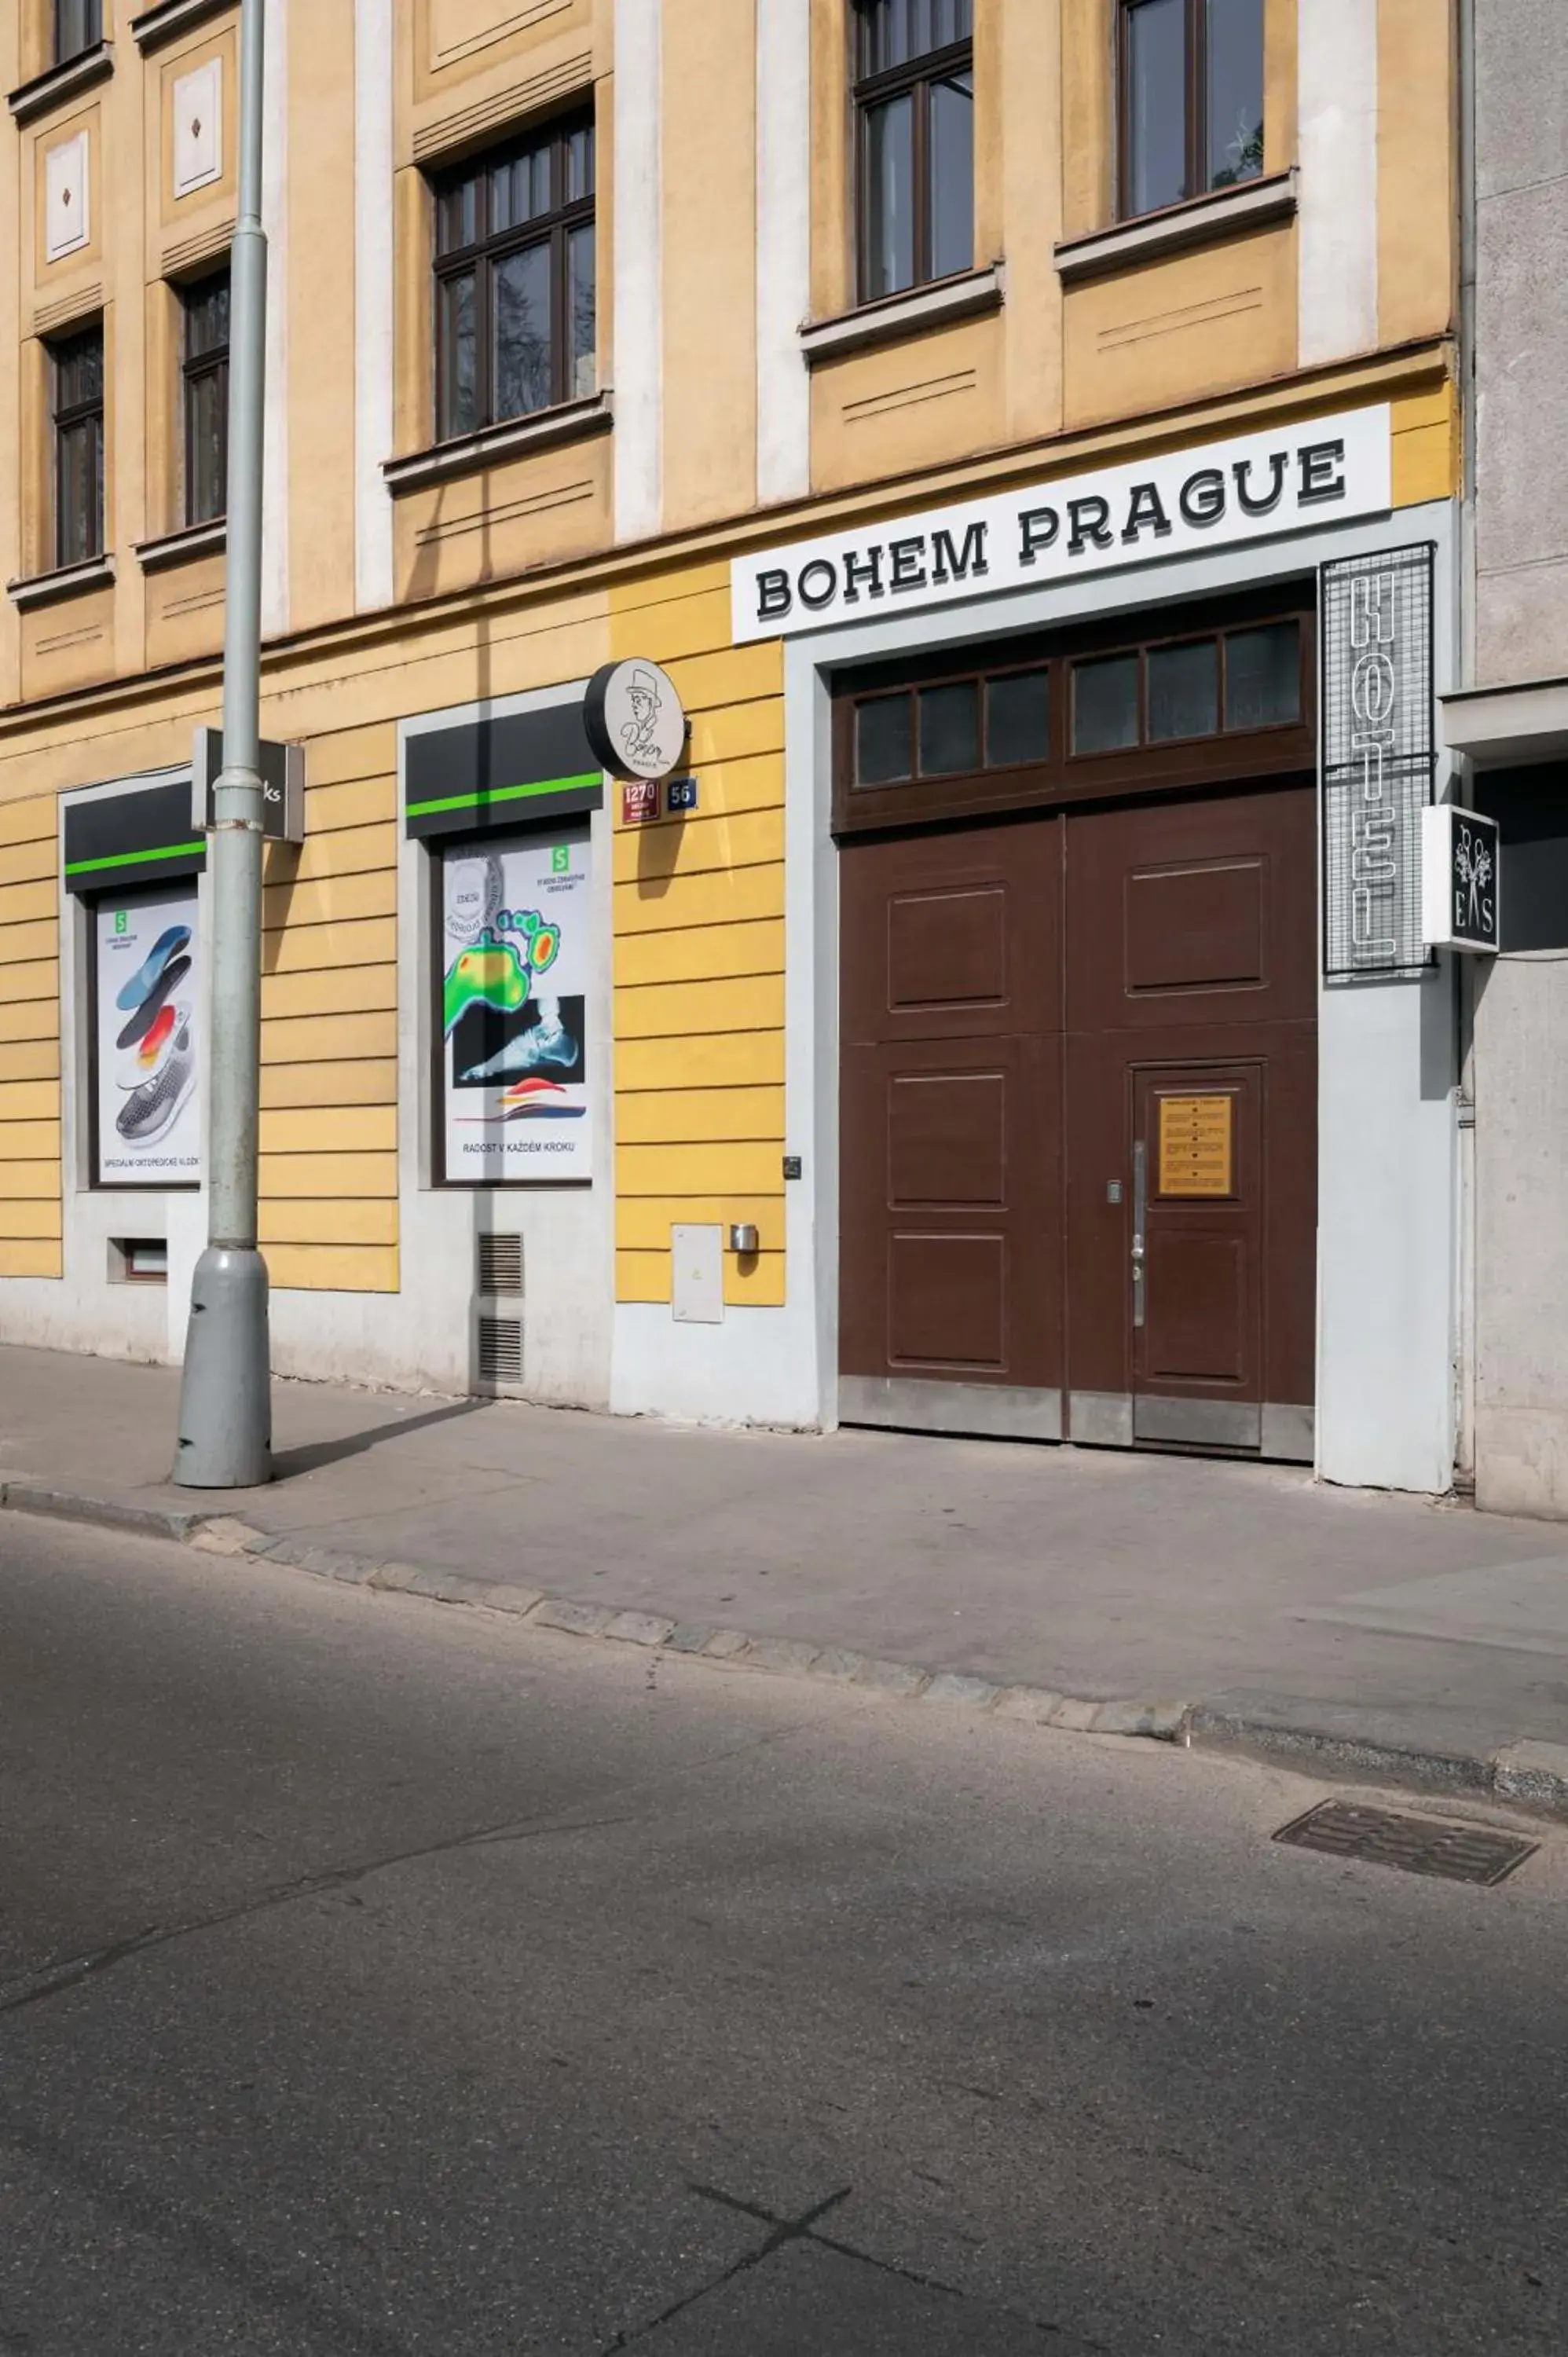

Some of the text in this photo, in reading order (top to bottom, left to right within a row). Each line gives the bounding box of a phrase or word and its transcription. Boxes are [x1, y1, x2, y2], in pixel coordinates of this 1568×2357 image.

[757, 438, 1346, 618] BOHEM PRAGUE
[1350, 571, 1396, 959] HOTEL
[264, 779, 280, 801] ks
[626, 783, 655, 804] 1270
[672, 786, 691, 804] 56
[463, 1140, 575, 1153] RADOST V KAŽDÉM KROKU
